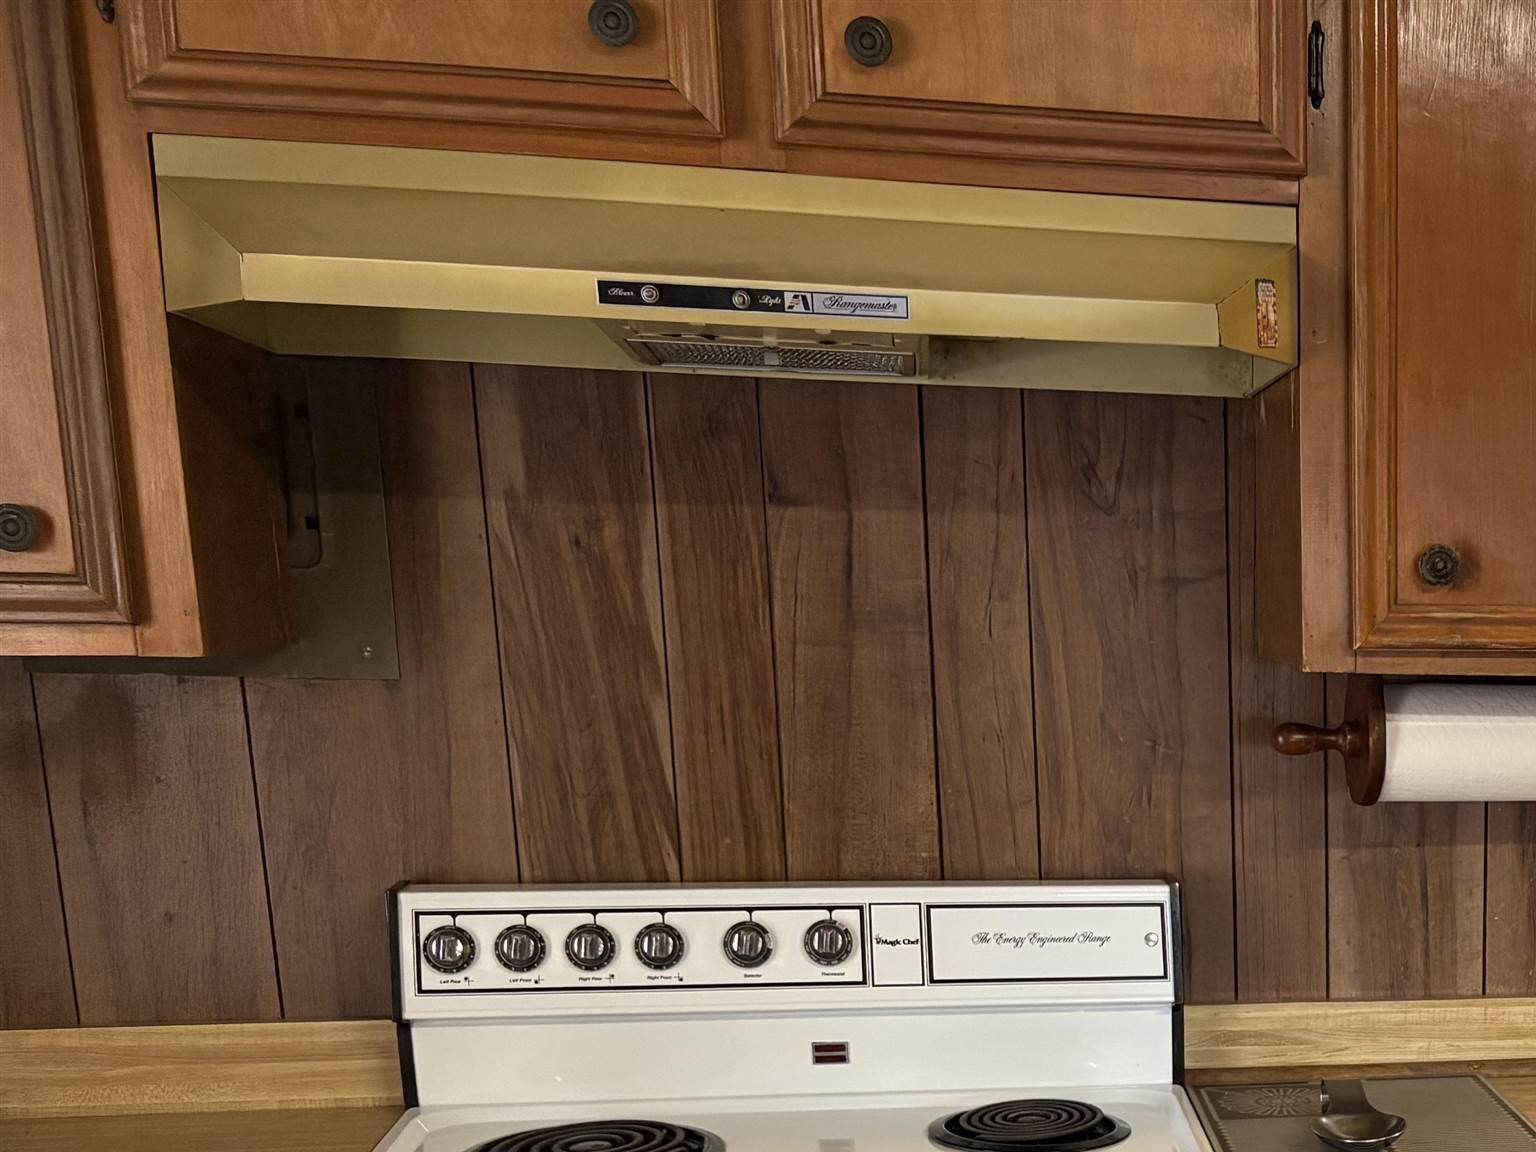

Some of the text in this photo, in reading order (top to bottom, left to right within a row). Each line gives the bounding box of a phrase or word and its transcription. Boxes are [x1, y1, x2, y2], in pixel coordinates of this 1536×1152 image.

[822, 295, 898, 313] Rangemaster
[881, 938, 902, 947] Magic
[971, 931, 1112, 949] The Energy Engineered Range
